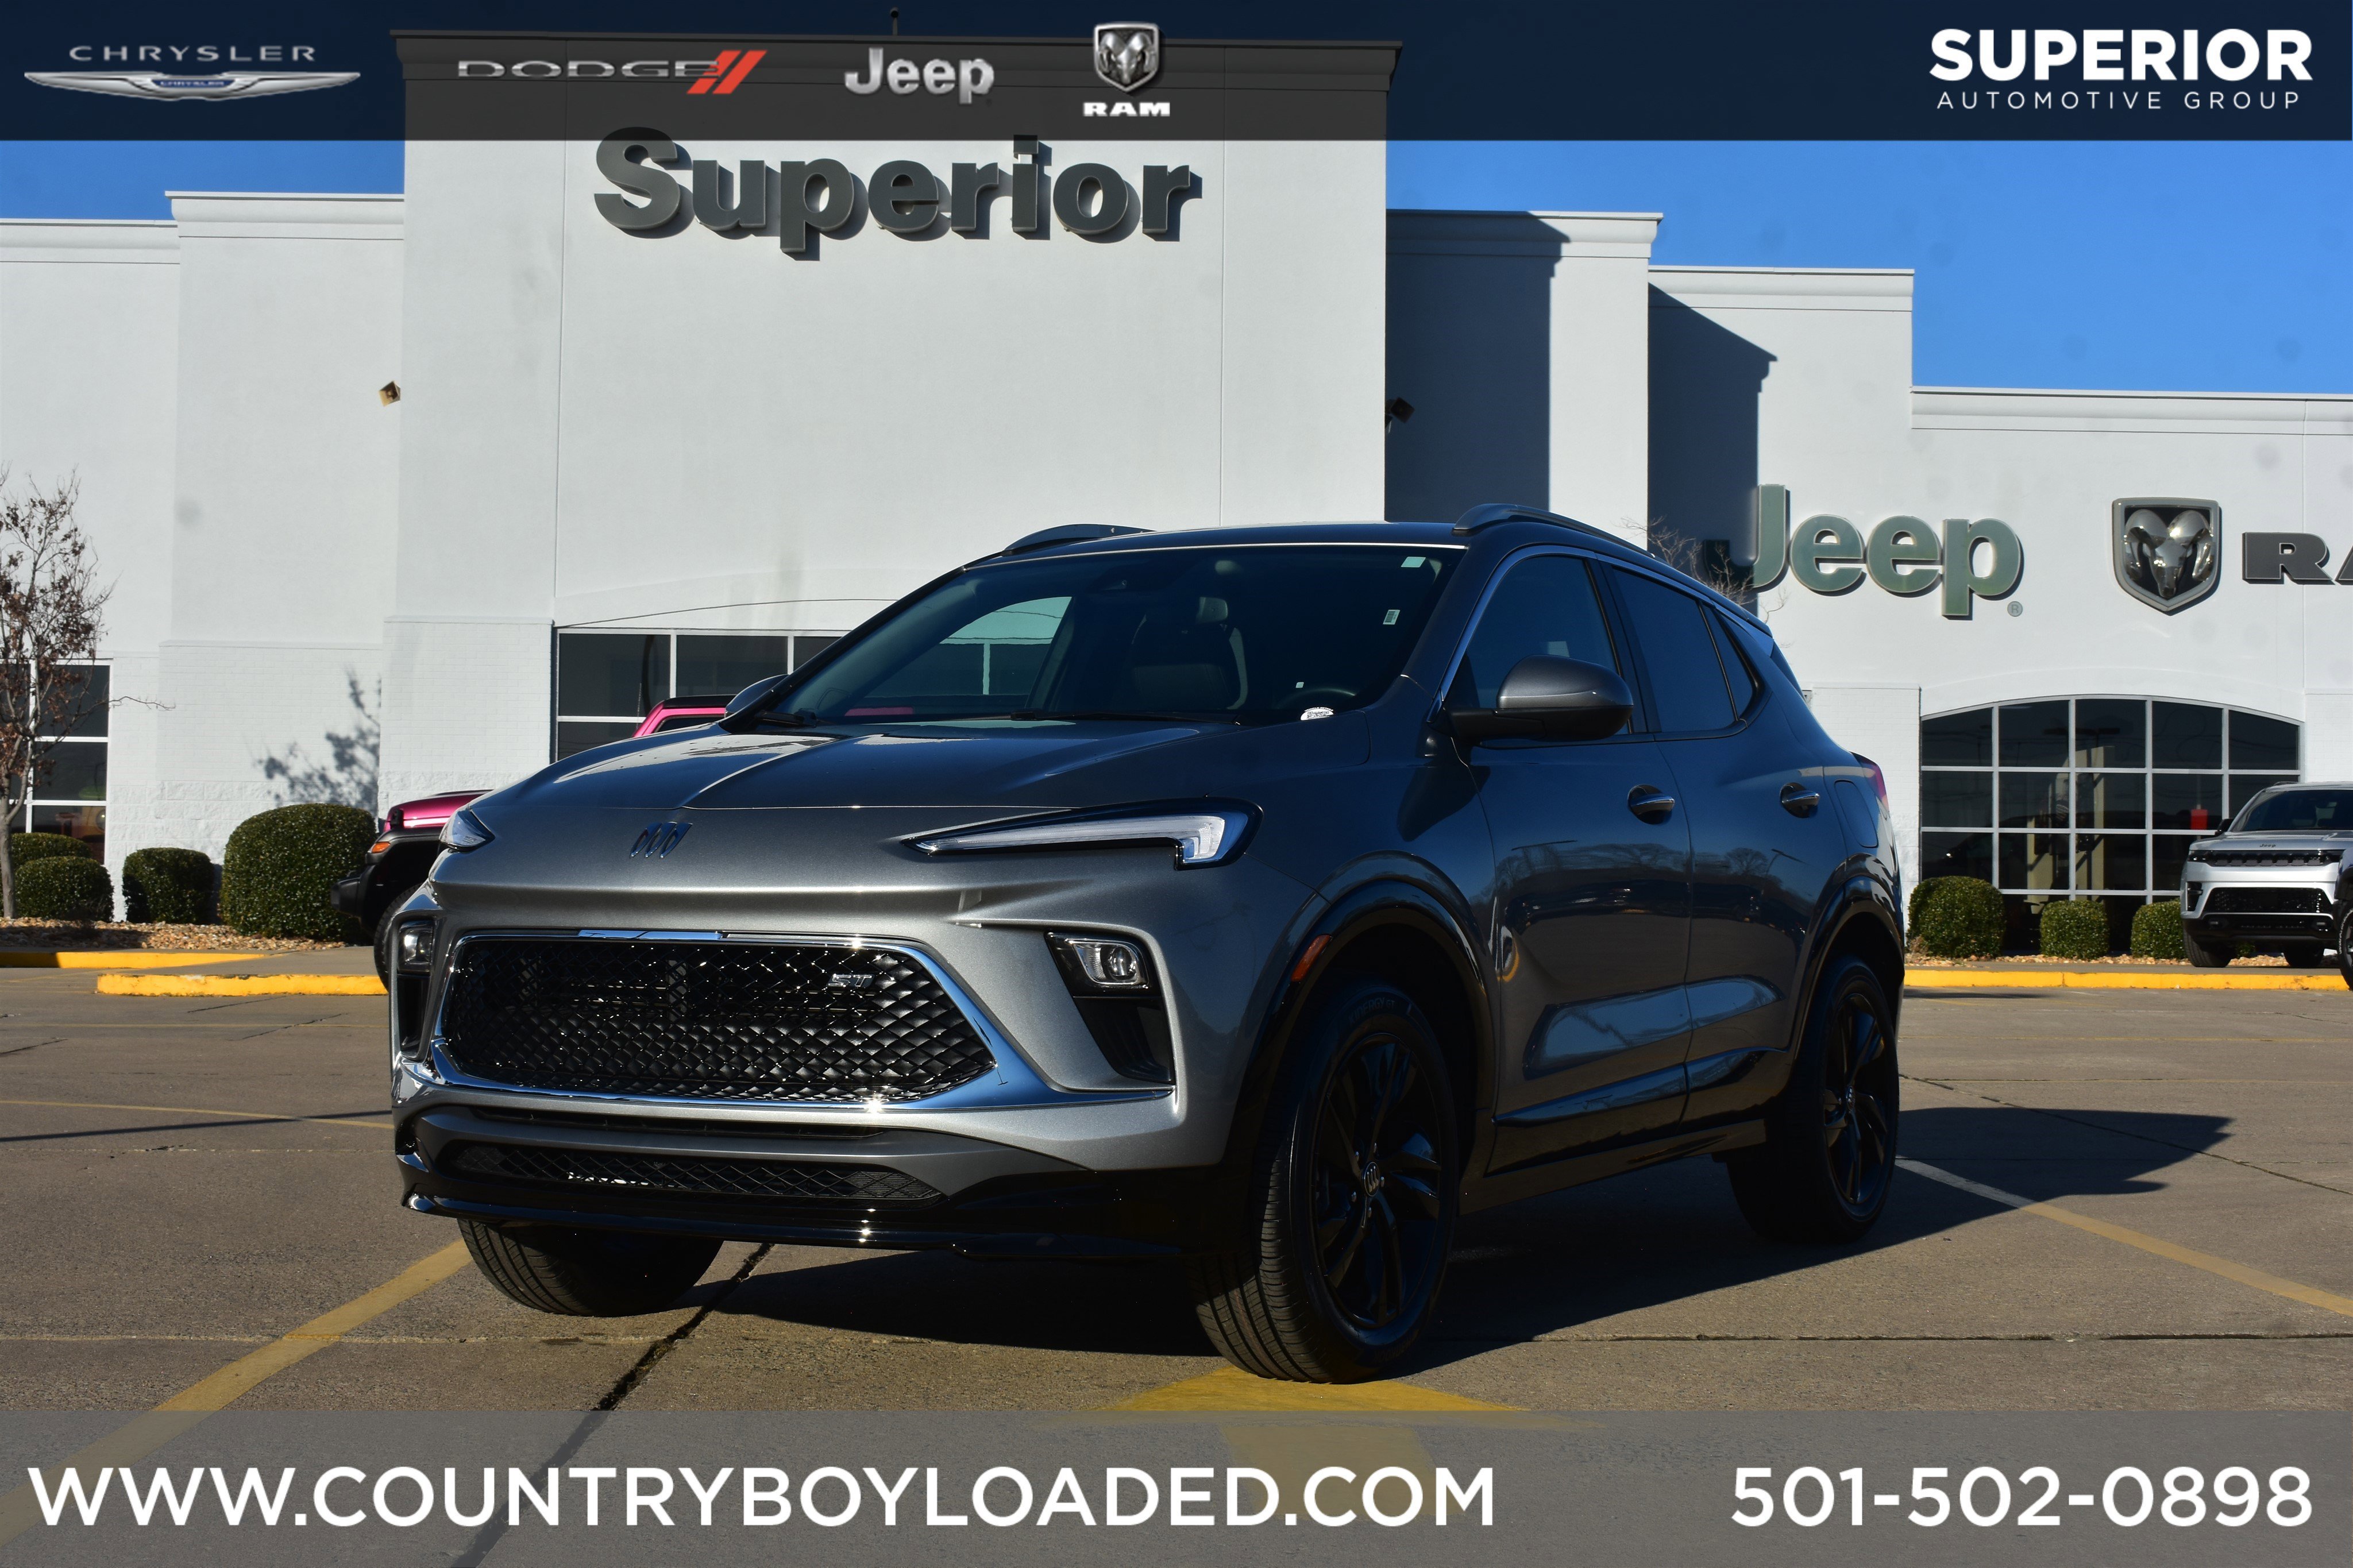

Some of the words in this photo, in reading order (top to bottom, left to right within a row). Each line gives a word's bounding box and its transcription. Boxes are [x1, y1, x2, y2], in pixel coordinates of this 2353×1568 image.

[593, 126, 1190, 253] Superior
[1703, 484, 2021, 616] Jeep
[2242, 532, 2353, 581] R
[828, 974, 872, 987] ST
